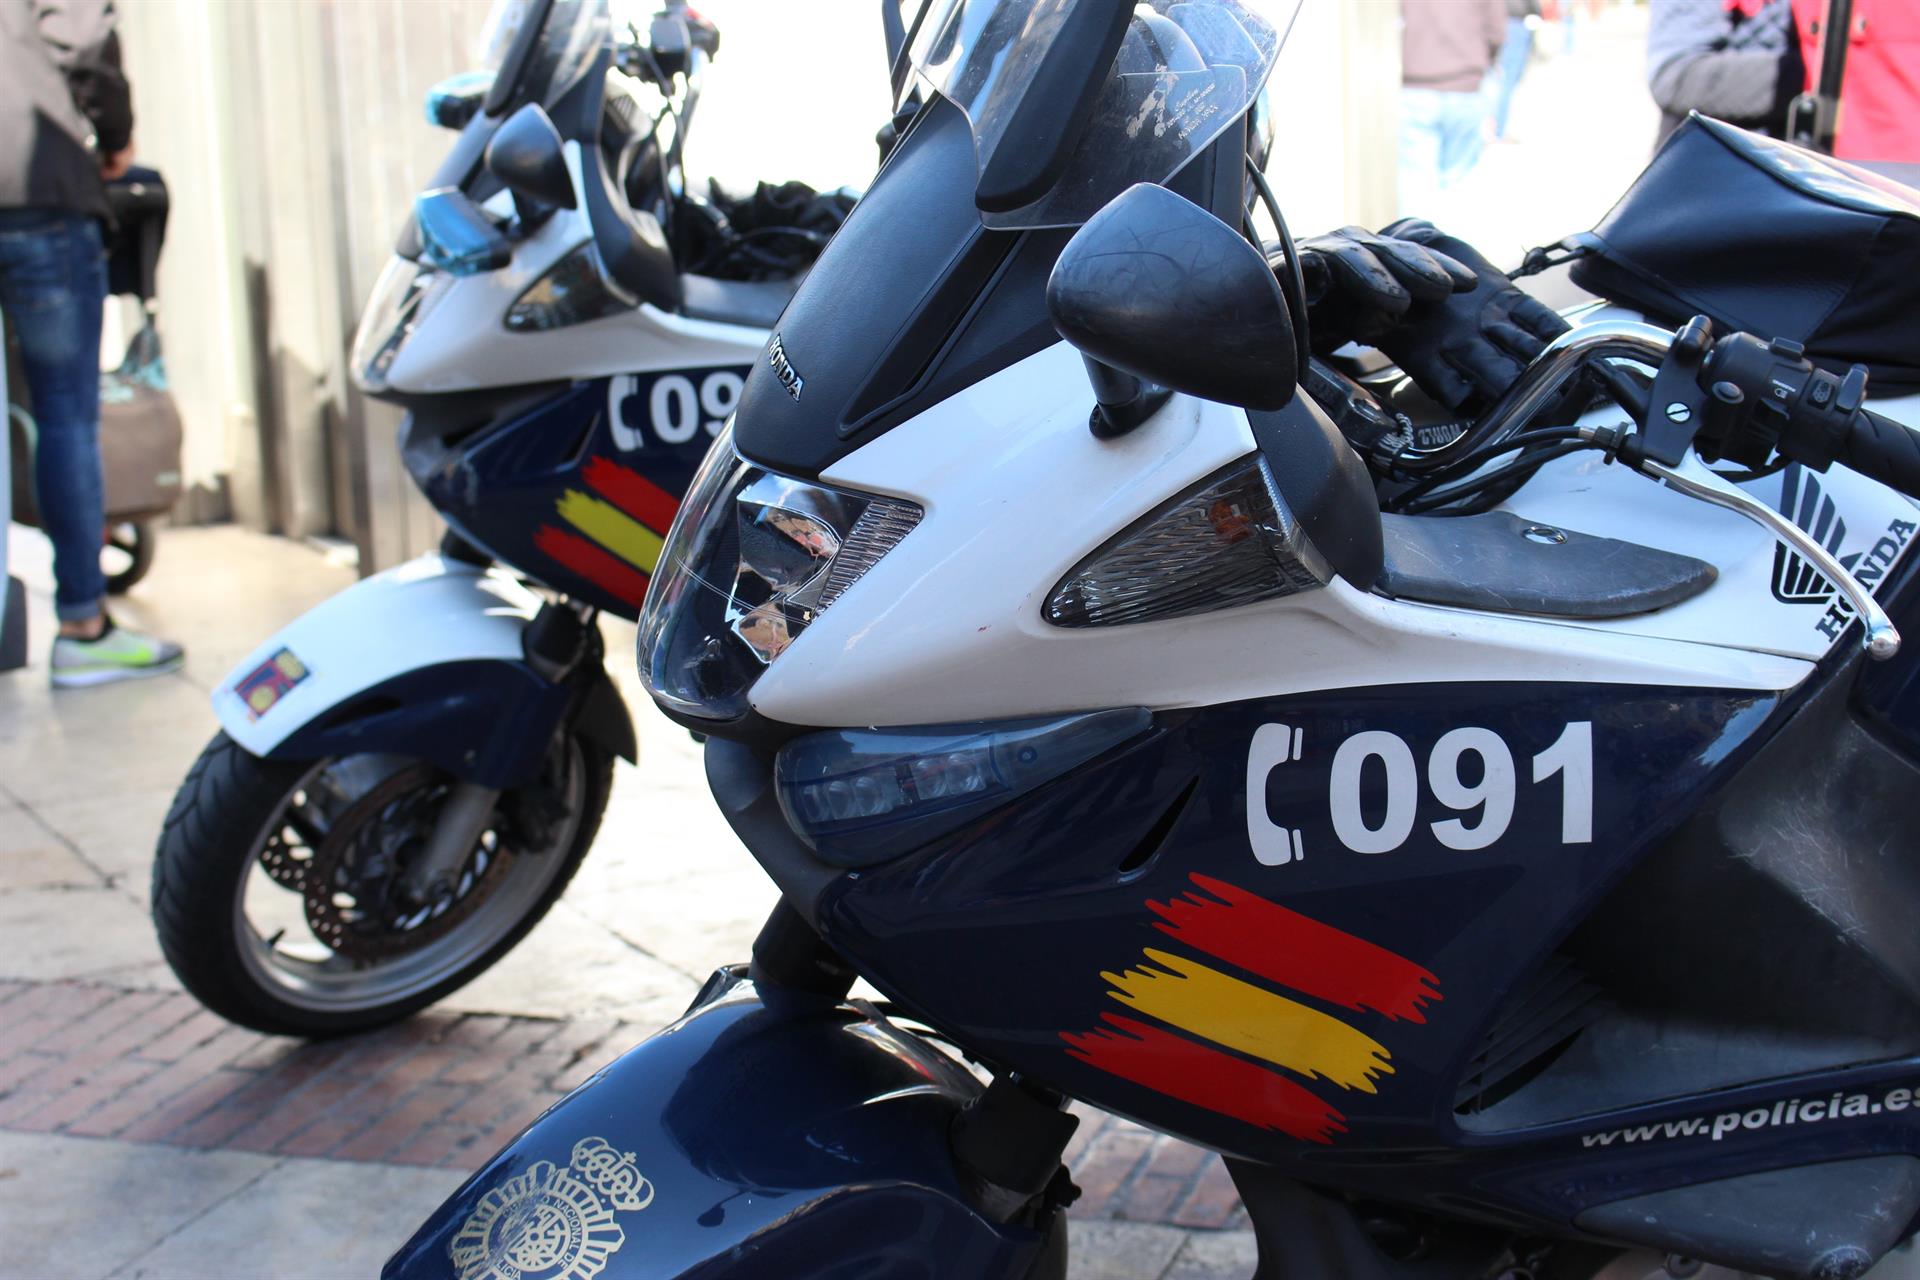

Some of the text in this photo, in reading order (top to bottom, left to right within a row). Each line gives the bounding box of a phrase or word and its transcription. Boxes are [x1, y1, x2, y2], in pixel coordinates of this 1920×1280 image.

[769, 334, 803, 401] HONDA
[1329, 721, 1593, 854] 091
[553, 1198, 582, 1250] NACIONAL
[557, 1252, 575, 1270] DE
